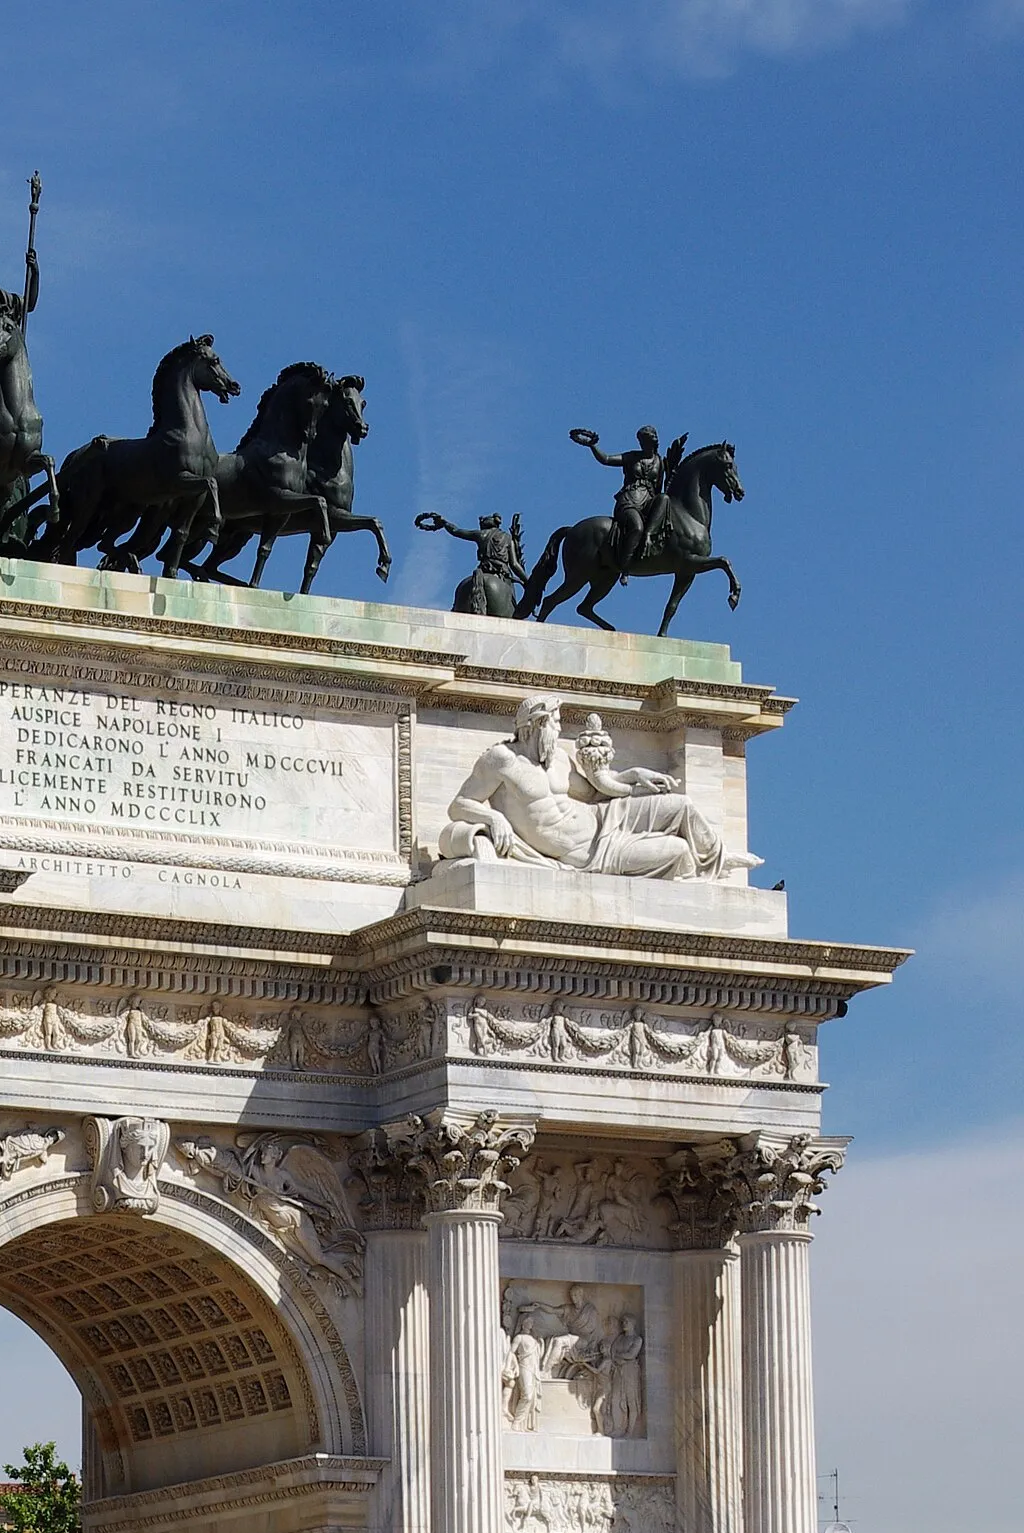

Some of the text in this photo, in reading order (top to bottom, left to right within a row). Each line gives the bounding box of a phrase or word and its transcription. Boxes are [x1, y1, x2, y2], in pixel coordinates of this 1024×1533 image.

[10, 706, 222, 743] AUSPICE NAPOLEONE I
[106, 694, 142, 712] DEL
[156, 700, 216, 720] REGNO
[231, 708, 304, 730] ITALICO
[16, 749, 113, 774] FRANCATI
[132, 762, 156, 778] DA
[172, 766, 249, 788] SERVITU
[18, 727, 143, 755] DEDICARONO
[179, 747, 230, 765] ANNO
[246, 752, 343, 777] MDCCCVII
[40, 795, 96, 813] ANNO
[110, 802, 221, 827] MDCCCLIX
[123, 782, 266, 810] RESTITUIRONO
[17, 856, 242, 889] ARCHITETTO CAGNOLA
